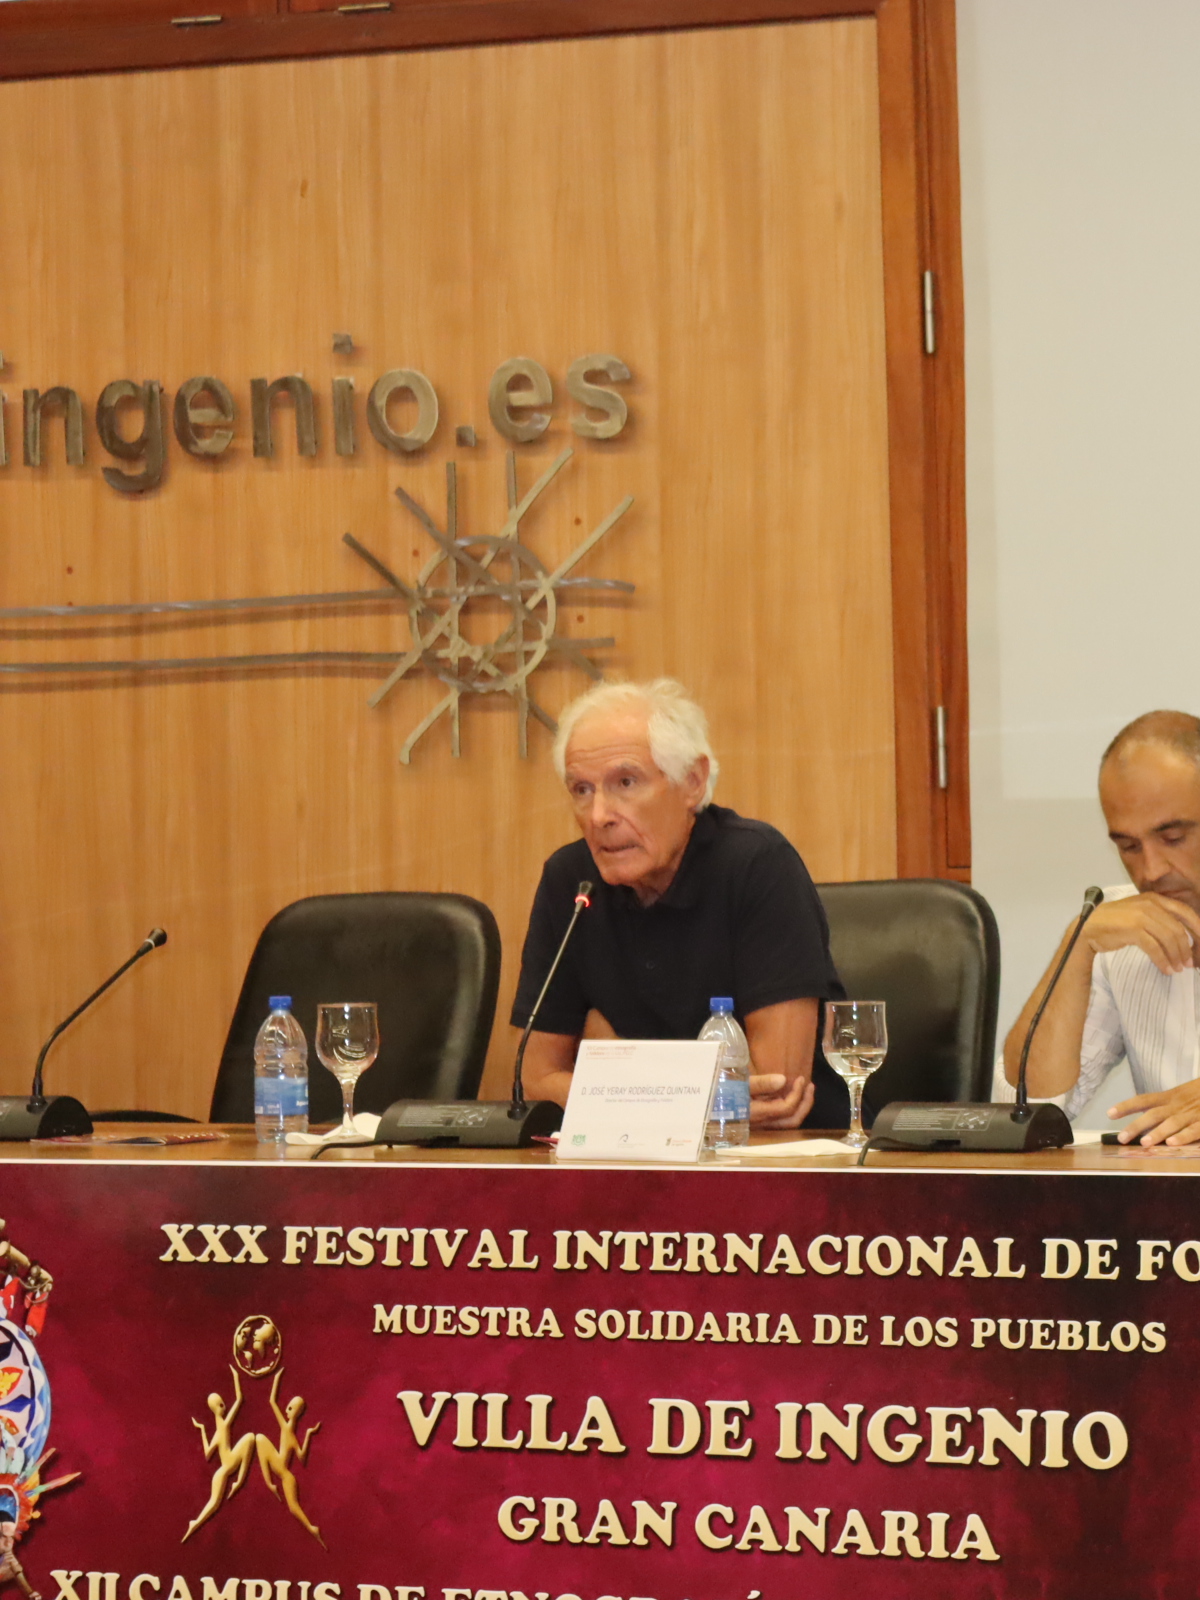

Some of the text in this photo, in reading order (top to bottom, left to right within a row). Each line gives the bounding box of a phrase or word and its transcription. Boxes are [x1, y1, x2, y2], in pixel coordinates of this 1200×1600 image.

[589, 1085, 605, 1096] JOSÉ
[628, 1084, 665, 1096] RODRÍGUEZ
[666, 1086, 701, 1096] QUINTANA
[158, 1223, 269, 1264] XXX
[281, 1225, 539, 1270] FESTIVAL
[552, 1229, 1026, 1280] INTERNACIONAL
[1040, 1237, 1120, 1281] DE
[372, 1303, 1168, 1354] MUESTRA SOLIDARIA DE LOS PUEBLOS
[396, 1390, 1130, 1471] VILLA DE INGENIO
[497, 1495, 1002, 1562] GRAN CANARIA
